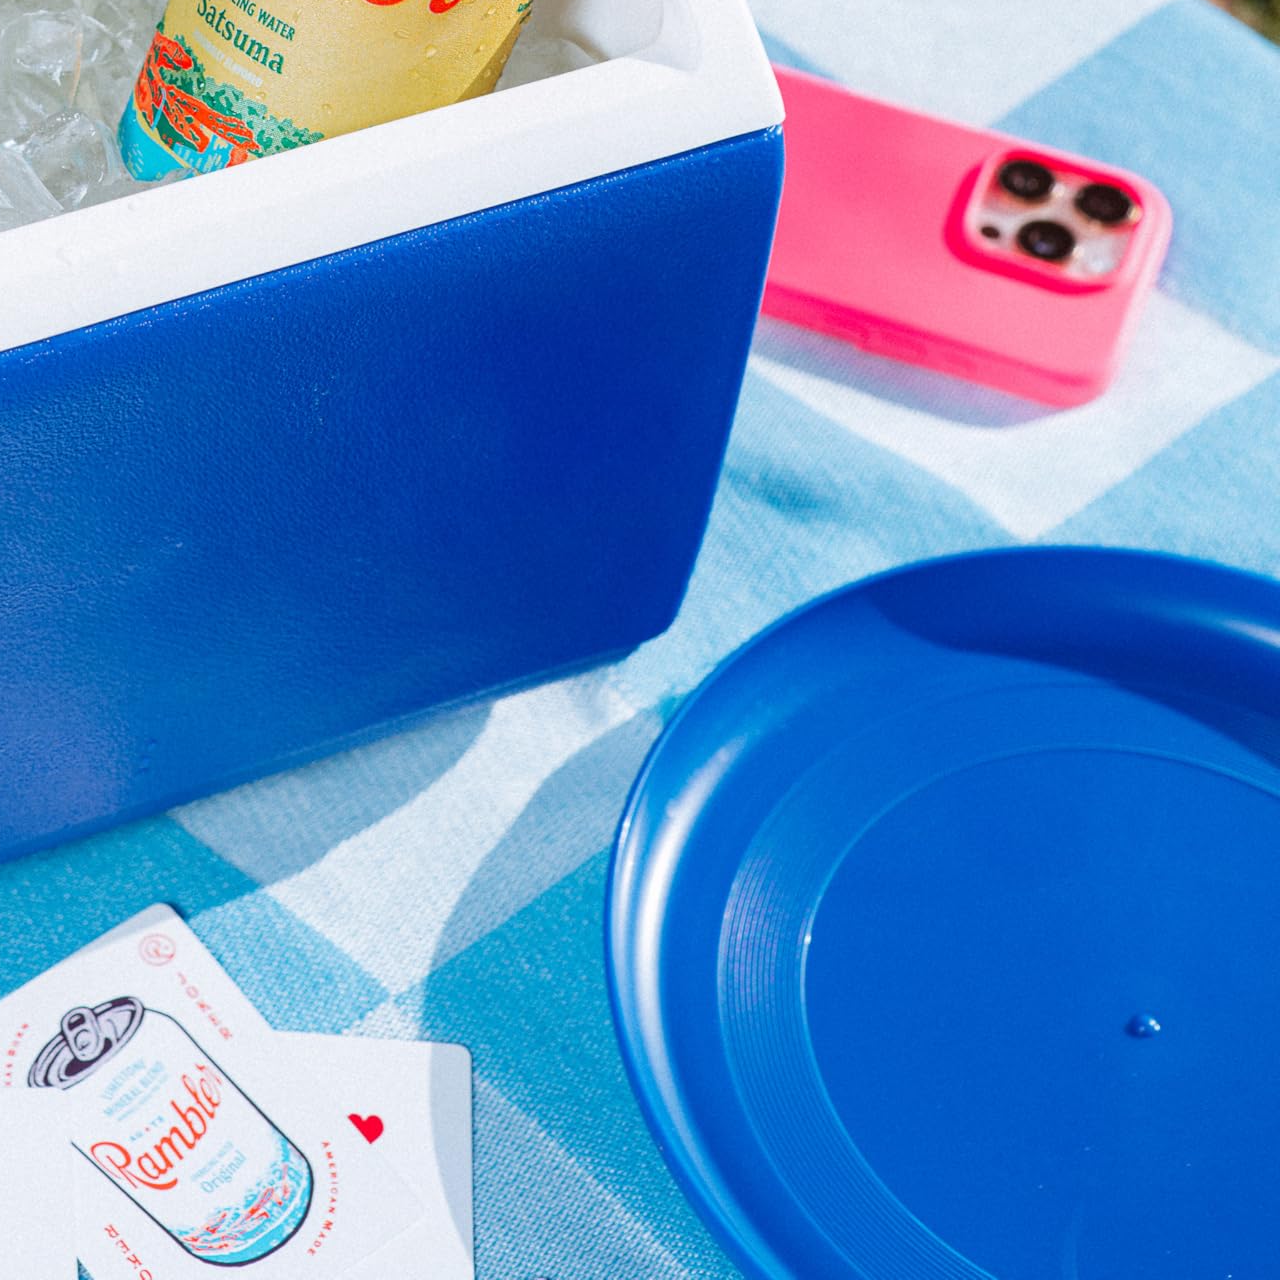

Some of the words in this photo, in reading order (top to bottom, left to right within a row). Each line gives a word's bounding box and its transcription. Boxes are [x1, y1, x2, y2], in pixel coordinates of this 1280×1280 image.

[257, 8, 296, 42] WATER
[177, 971, 233, 1040] JOKER
[103, 1223, 153, 1280] OKER
